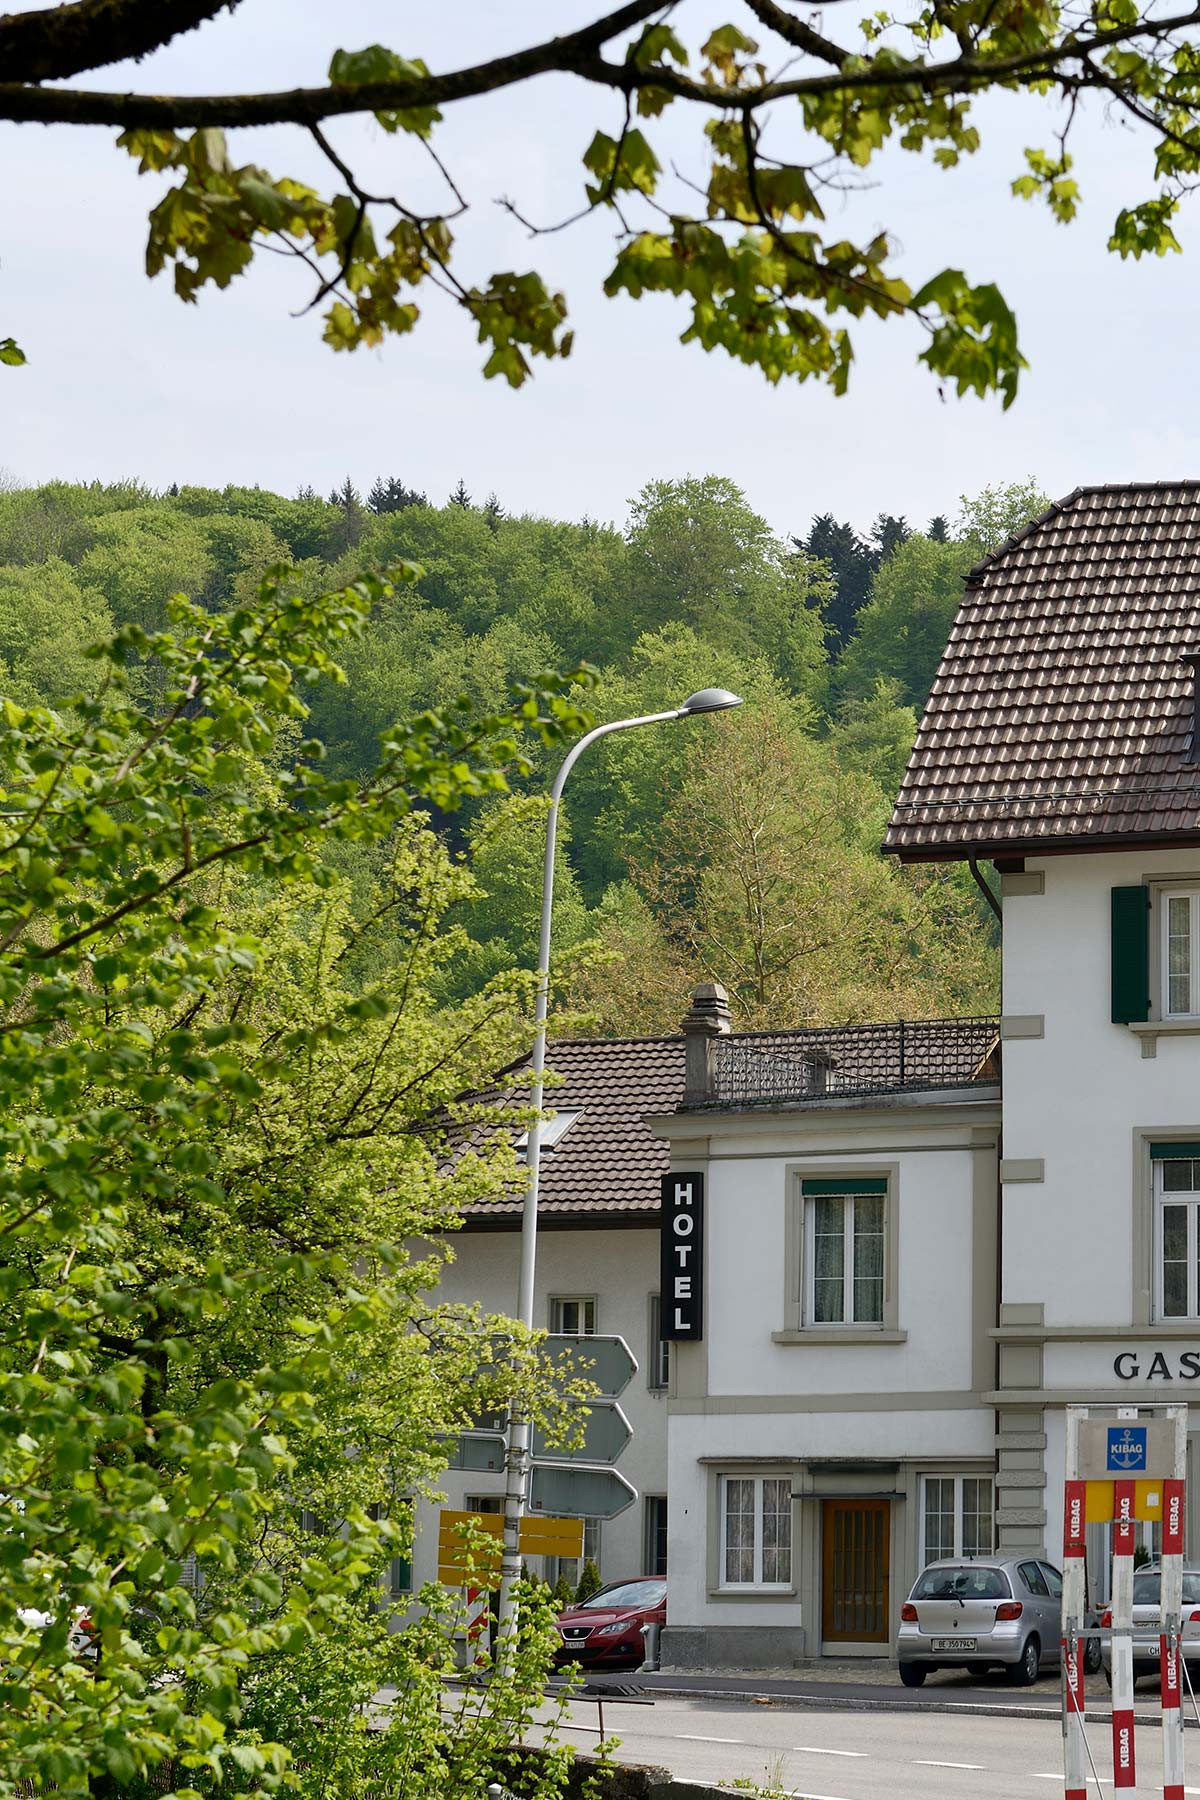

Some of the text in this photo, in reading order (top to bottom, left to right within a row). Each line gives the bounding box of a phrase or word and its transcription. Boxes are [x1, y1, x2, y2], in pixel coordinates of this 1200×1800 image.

[673, 1183, 694, 1330] HOTEL
[1111, 1444, 1143, 1454] KIBAG
[1070, 1499, 1080, 1538] KIBAG
[1169, 1497, 1179, 1535] KIBAG
[1149, 1647, 1160, 1656] CH
[1119, 1728, 1129, 1768] KIBAG
